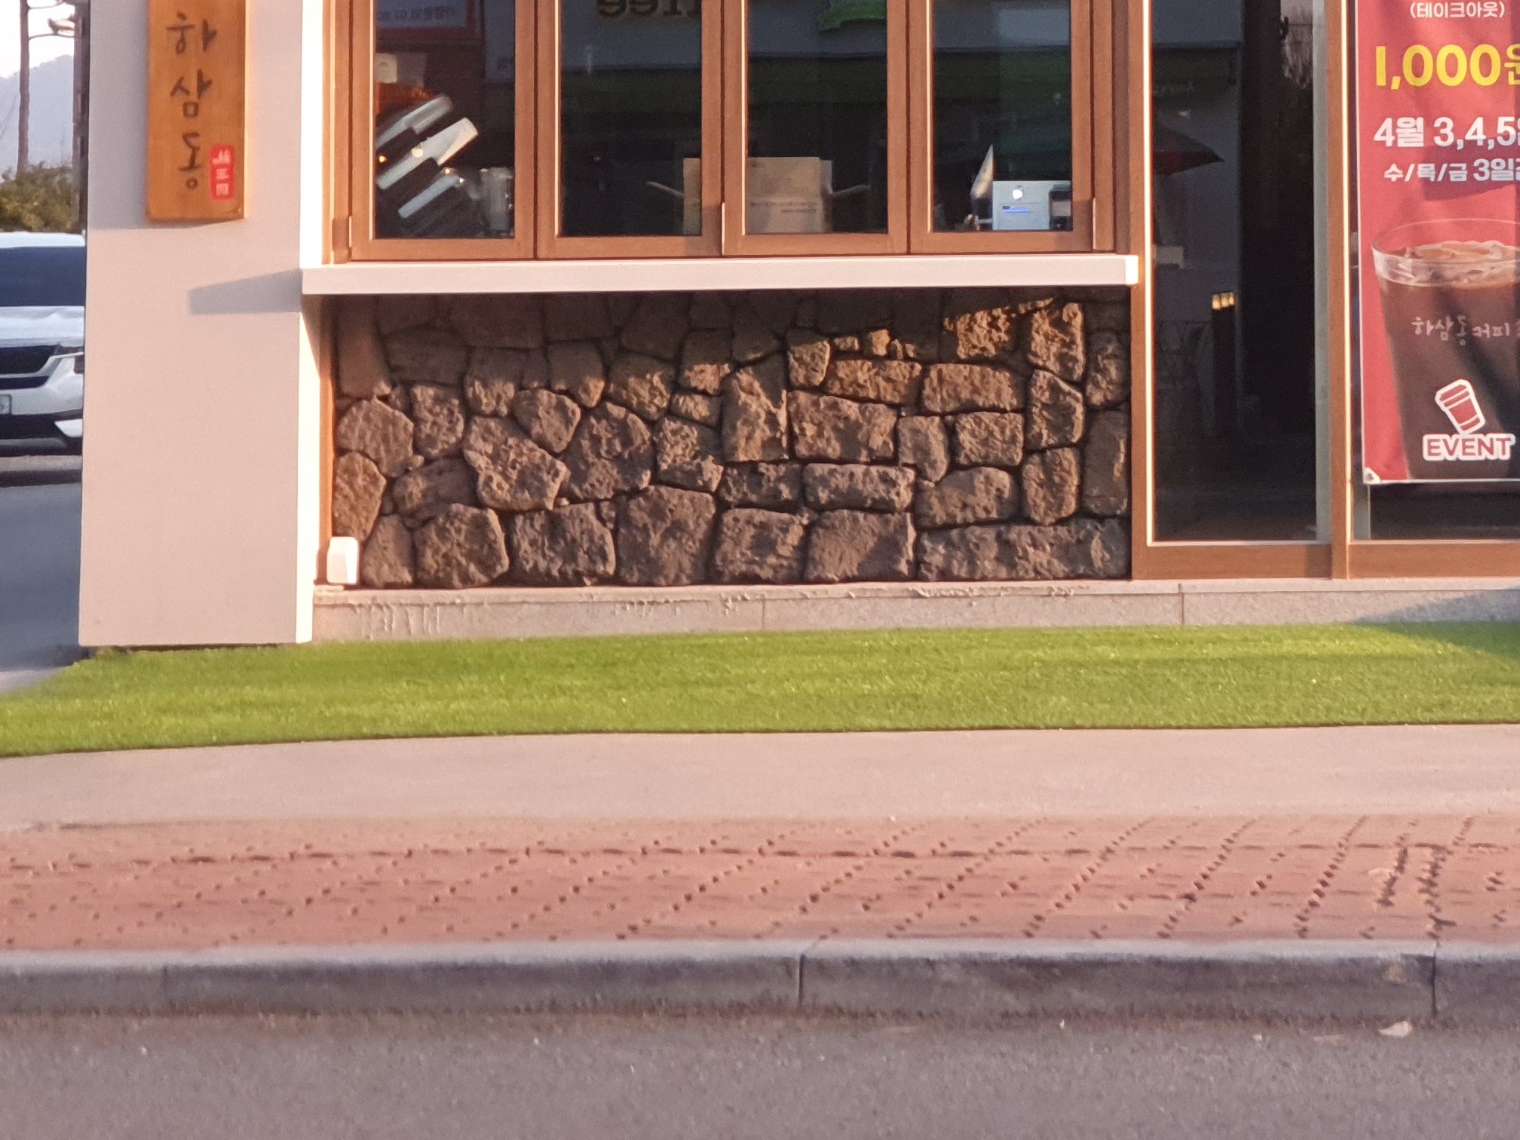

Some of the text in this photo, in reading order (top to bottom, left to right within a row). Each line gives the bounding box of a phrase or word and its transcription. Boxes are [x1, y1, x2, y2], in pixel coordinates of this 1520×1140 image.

[1409, 2, 1506, 19] (테이크아웃)
[166, 12, 218, 190] 하삼동
[1373, 116, 1425, 148] 4월
[1384, 163, 1468, 183] 수/목/금
[1424, 435, 1513, 460] EVENT
